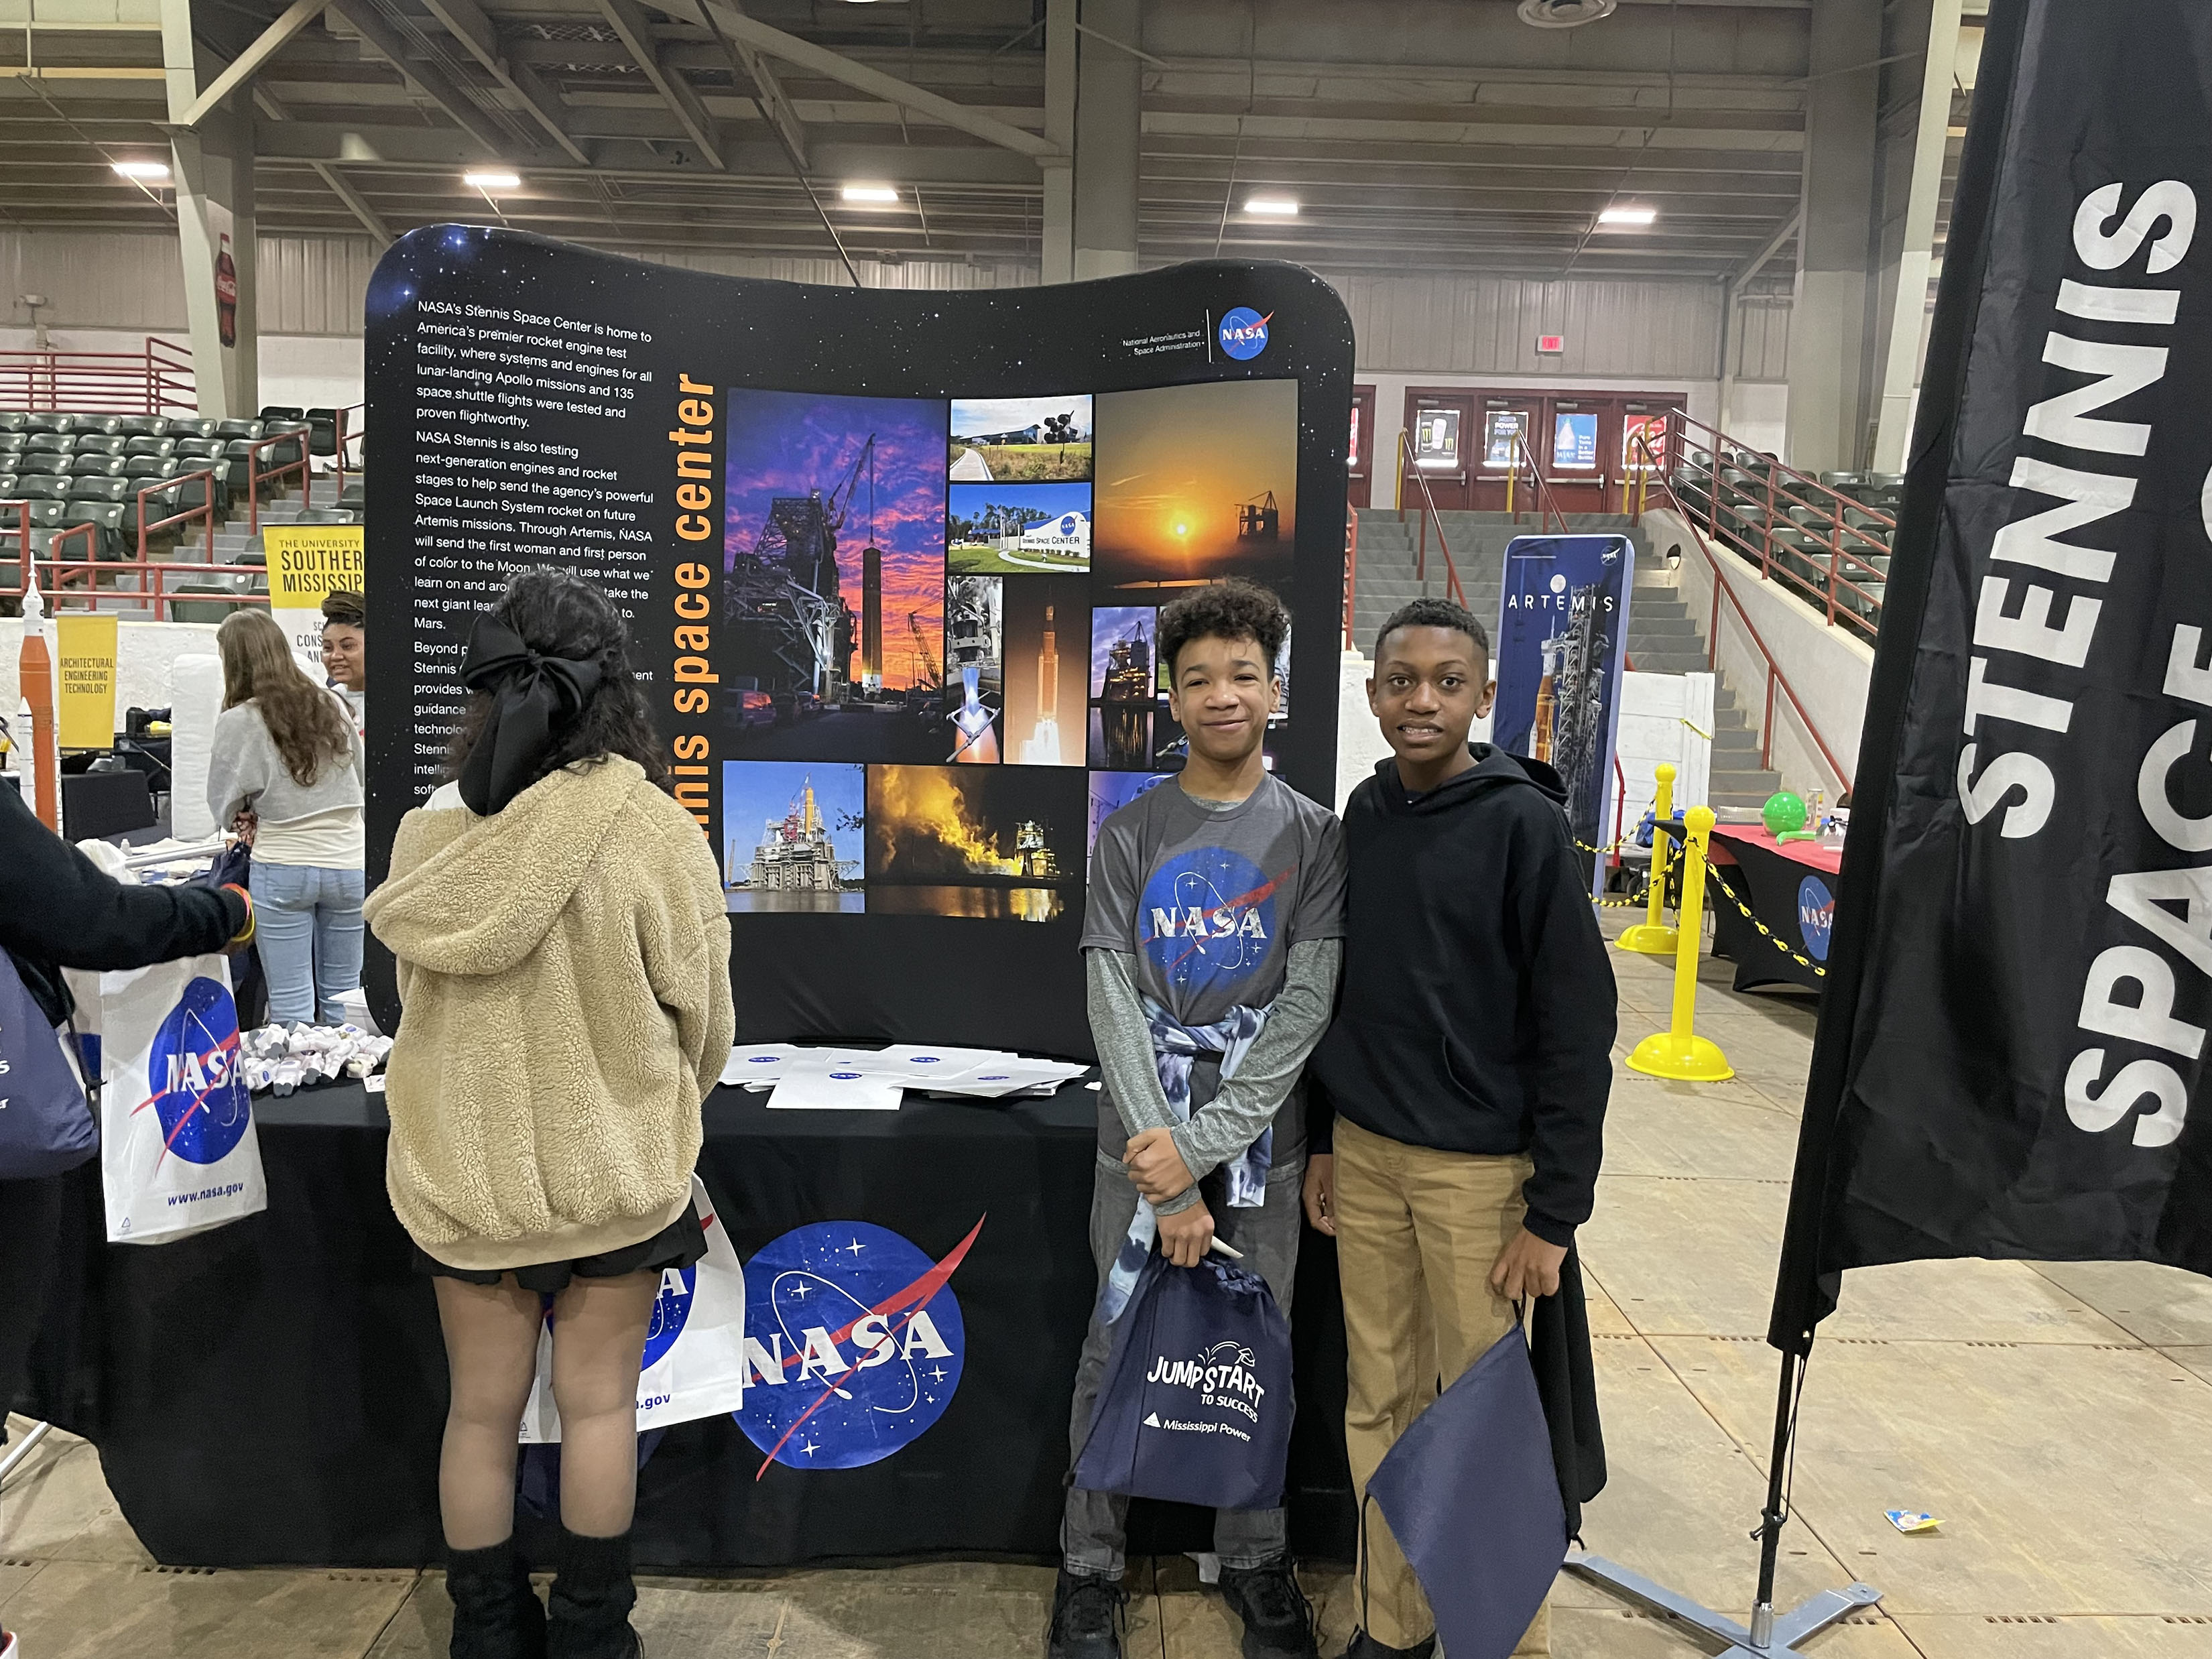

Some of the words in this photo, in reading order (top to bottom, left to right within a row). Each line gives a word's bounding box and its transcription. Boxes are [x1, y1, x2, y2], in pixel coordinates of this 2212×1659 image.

[418, 300, 462, 315] NASA's
[465, 304, 510, 320] Stennis
[512, 310, 551, 326] Space
[553, 316, 592, 333] Center
[594, 323, 604, 335] is
[606, 325, 638, 341] home
[640, 331, 652, 343] to
[417, 321, 475, 338] America's
[478, 329, 524, 343] premier
[526, 335, 563, 349] rocket
[565, 341, 604, 355] engine
[606, 346, 627, 359] test
[1123, 338, 1148, 347] National
[1149, 332, 1186, 343] Aeronautics
[1187, 330, 1201, 338] and
[1222, 327, 1266, 341] NASA
[1133, 347, 1154, 356] Space
[1155, 341, 1201, 353] Administration
[416, 342, 458, 360] facility,
[460, 347, 497, 361] where
[499, 353, 548, 368] systems
[550, 360, 573, 371] and
[575, 363, 619, 378] engines
[622, 367, 638, 380] for
[639, 371, 652, 382] all
[416, 363, 493, 385] lunar-landing
[495, 370, 533, 387] Apollo
[536, 377, 587, 393] missions
[589, 385, 611, 397] and
[613, 387, 634, 400] 135
[416, 387, 452, 399] space
[454, 388, 495, 403] shuttle
[497, 391, 533, 408] flights
[536, 399, 564, 411] were
[566, 401, 602, 416] tested
[604, 408, 626, 418] and
[416, 408, 456, 420] proven
[459, 409, 530, 430] flightworthy.
[416, 430, 451, 444] NASA
[453, 433, 497, 449] Stennis
[500, 440, 511, 450] is
[513, 440, 538, 452] also
[540, 442, 579, 460] testing
[416, 454, 507, 471] next-generation
[509, 460, 555, 476] engines
[557, 463, 580, 478] and
[582, 469, 617, 481] rocket
[668, 373, 713, 541] center
[415, 473, 454, 488] stages
[456, 476, 469, 487] to
[472, 477, 497, 492] help
[499, 481, 528, 493] send
[531, 482, 550, 495] the
[552, 486, 603, 501] agency's
[605, 491, 654, 503] powerful
[415, 493, 452, 507] Space
[455, 496, 498, 510] Launch
[501, 499, 544, 514] System
[548, 505, 583, 517] rocket
[586, 509, 601, 519] on
[603, 508, 636, 521] future
[1957, 179, 2197, 839] STENNIS
[414, 513, 459, 528] Artemis
[462, 518, 516, 534] missions.
[518, 521, 567, 538] Through
[569, 525, 616, 542] Artemis,
[619, 529, 653, 542] NASA
[279, 540, 298, 548] THE
[302, 539, 360, 548] UNIVERSITY
[414, 536, 433, 547] will
[436, 538, 465, 549] send
[467, 538, 487, 550] the
[489, 539, 511, 552] first
[513, 544, 556, 555] woman
[559, 546, 581, 557] and
[583, 546, 605, 560] first
[608, 550, 646, 561] person
[1052, 536, 1080, 544] CENTER
[281, 550, 363, 570] SOUTHER
[414, 555, 426, 567] of
[429, 556, 458, 568] color
[460, 558, 473, 570] to
[475, 559, 495, 571] the
[497, 560, 531, 574] Moon
[580, 568, 600, 577] use
[603, 568, 630, 579] what
[633, 571, 650, 580] we
[282, 573, 363, 593] MISSISSIP
[414, 576, 442, 589] learn
[445, 580, 460, 589] on
[463, 580, 485, 591] and
[489, 583, 510, 592] aro
[605, 587, 627, 599] take
[631, 589, 649, 599] the
[414, 598, 439, 609] next
[442, 598, 471, 612] giant
[1508, 594, 1613, 613] ARTEMIS
[414, 617, 446, 630] Mars.
[414, 641, 458, 656] Beyond
[674, 562, 719, 714] space
[60, 658, 114, 668] ARCHITECTURAL
[414, 662, 456, 674] Stennis
[64, 670, 108, 681] ENGINEERING
[65, 683, 107, 694] TECHNOLOGY
[414, 683, 463, 696] provides
[414, 703, 467, 717] guidance
[414, 723, 467, 735] technolo
[414, 743, 452, 755] Stenni
[414, 784, 437, 795] soft
[1151, 906, 1268, 939] NASA
[166, 1050, 249, 1094] NASA
[168, 1182, 244, 1207] www.nasa.gov
[742, 1310, 955, 1388] NASA
[1201, 1394, 1213, 1405] TO
[1215, 1394, 1259, 1424] SUCCESS
[1163, 1419, 1218, 1434] Mississippi
[1219, 1423, 1251, 1443] Power
